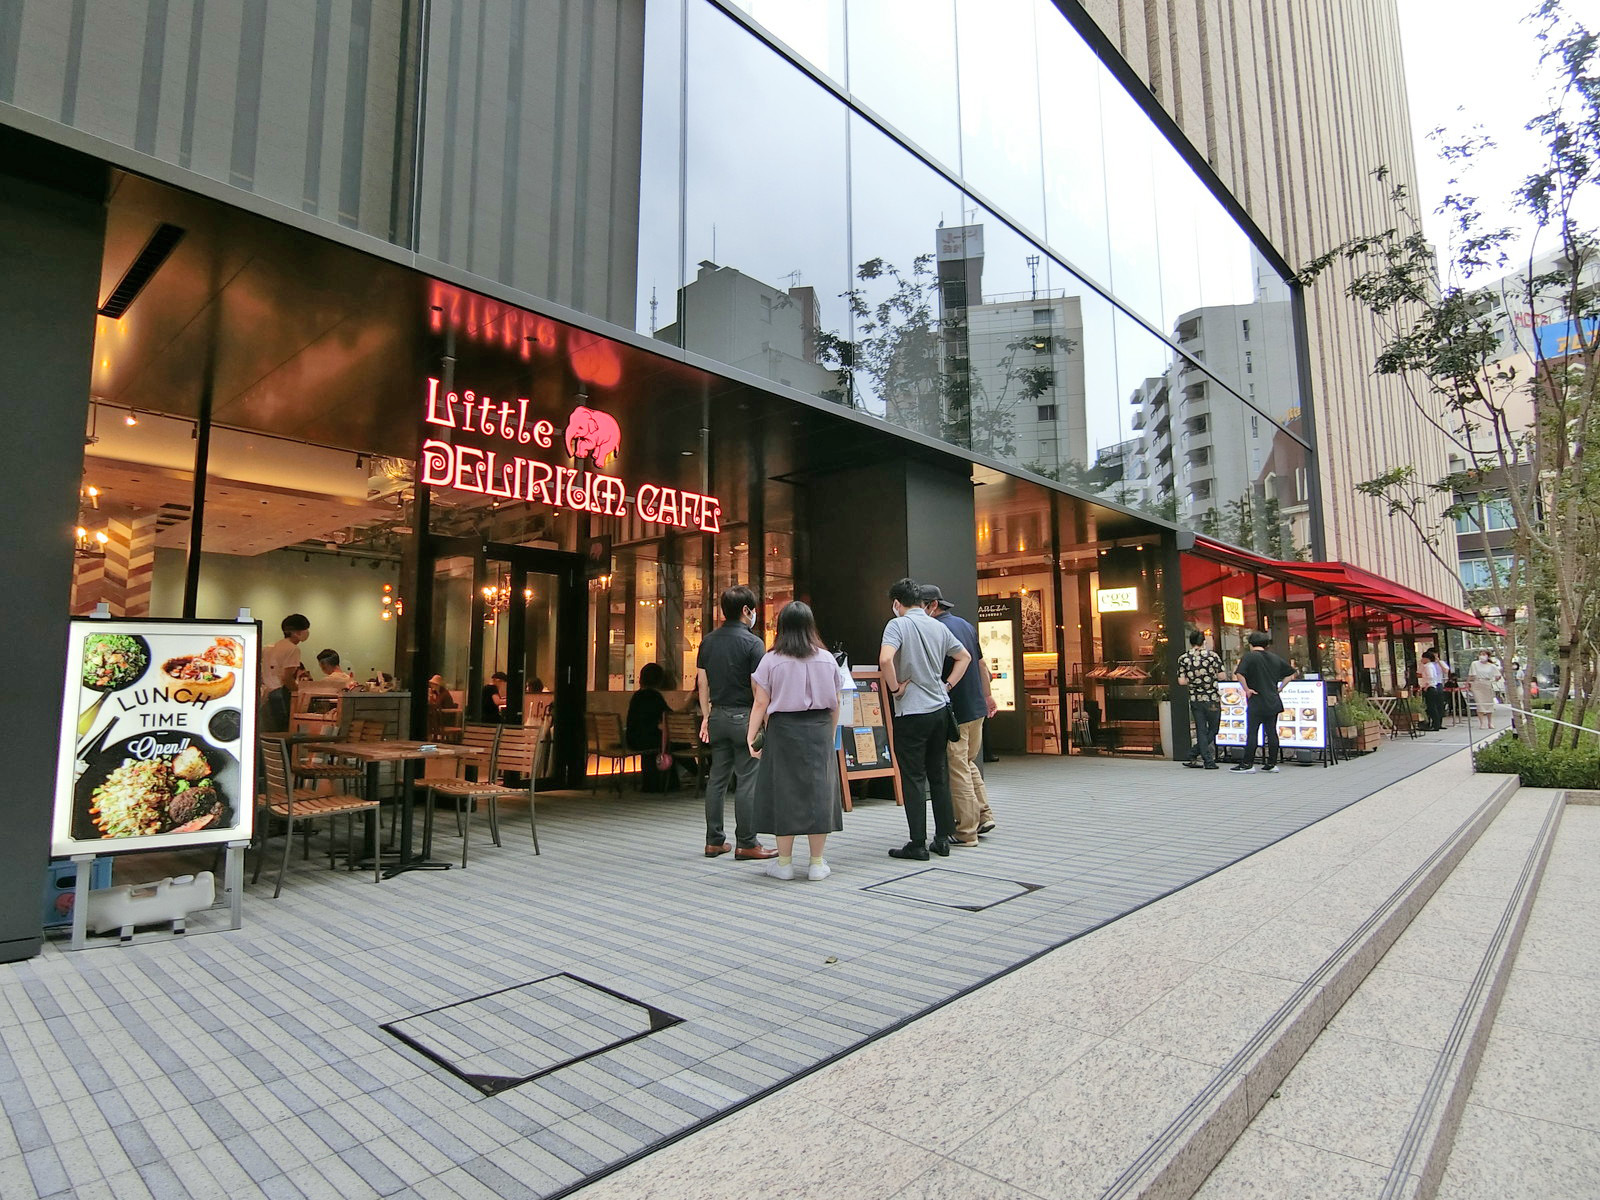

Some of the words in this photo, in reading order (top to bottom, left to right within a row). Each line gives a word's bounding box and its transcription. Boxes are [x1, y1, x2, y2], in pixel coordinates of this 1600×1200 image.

[425, 377, 555, 448] Little
[421, 438, 627, 517] DELIRIUM
[635, 483, 722, 534] CAFE
[1101, 592, 1132, 607] egg
[117, 687, 212, 712] LUNCH
[139, 713, 188, 727] TIME
[127, 736, 191, 760] Open!!
